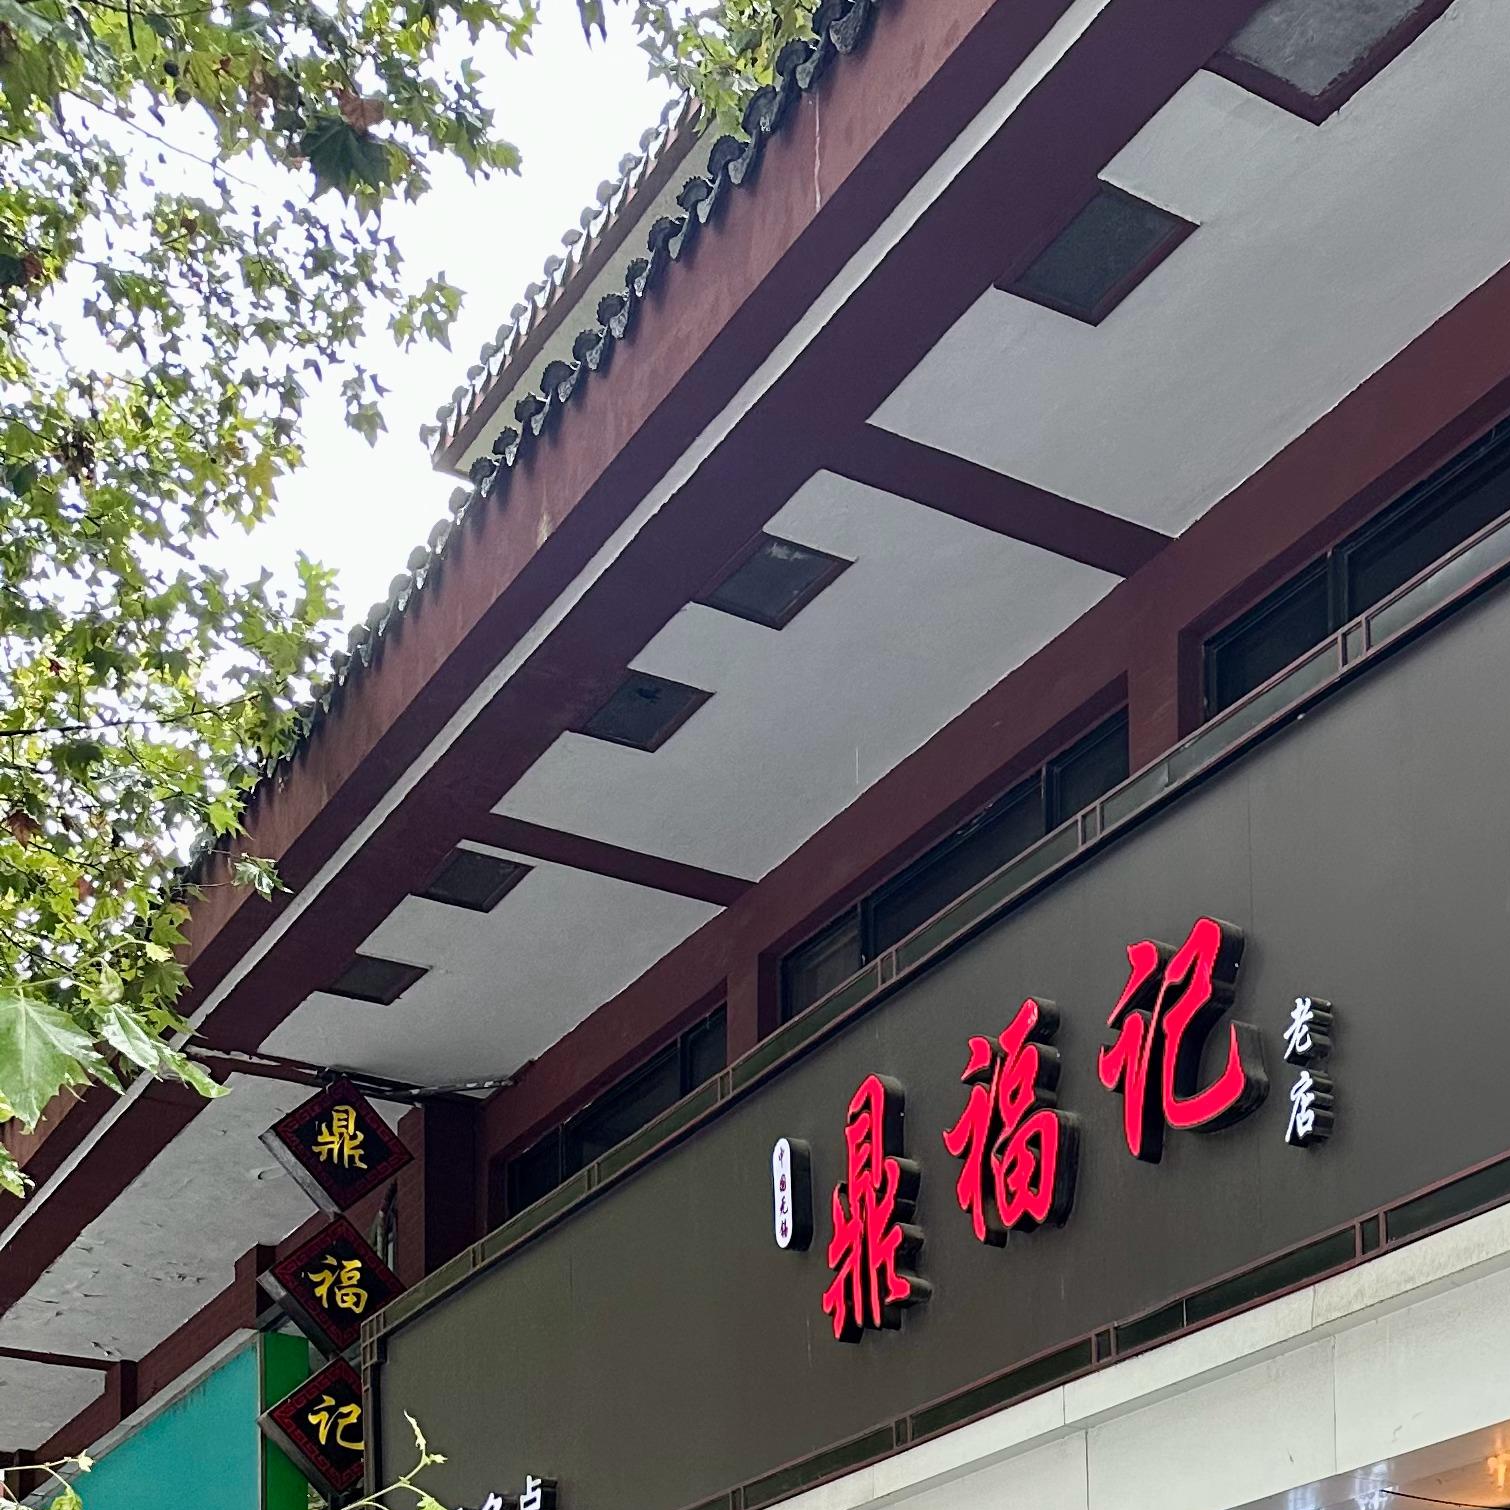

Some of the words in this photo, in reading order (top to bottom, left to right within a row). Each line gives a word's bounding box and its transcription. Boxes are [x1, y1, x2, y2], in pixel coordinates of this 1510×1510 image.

[821, 917, 1246, 1338] 鼎福记
[1283, 997, 1315, 1143] 老店
[311, 1106, 369, 1450] 鼎福记
